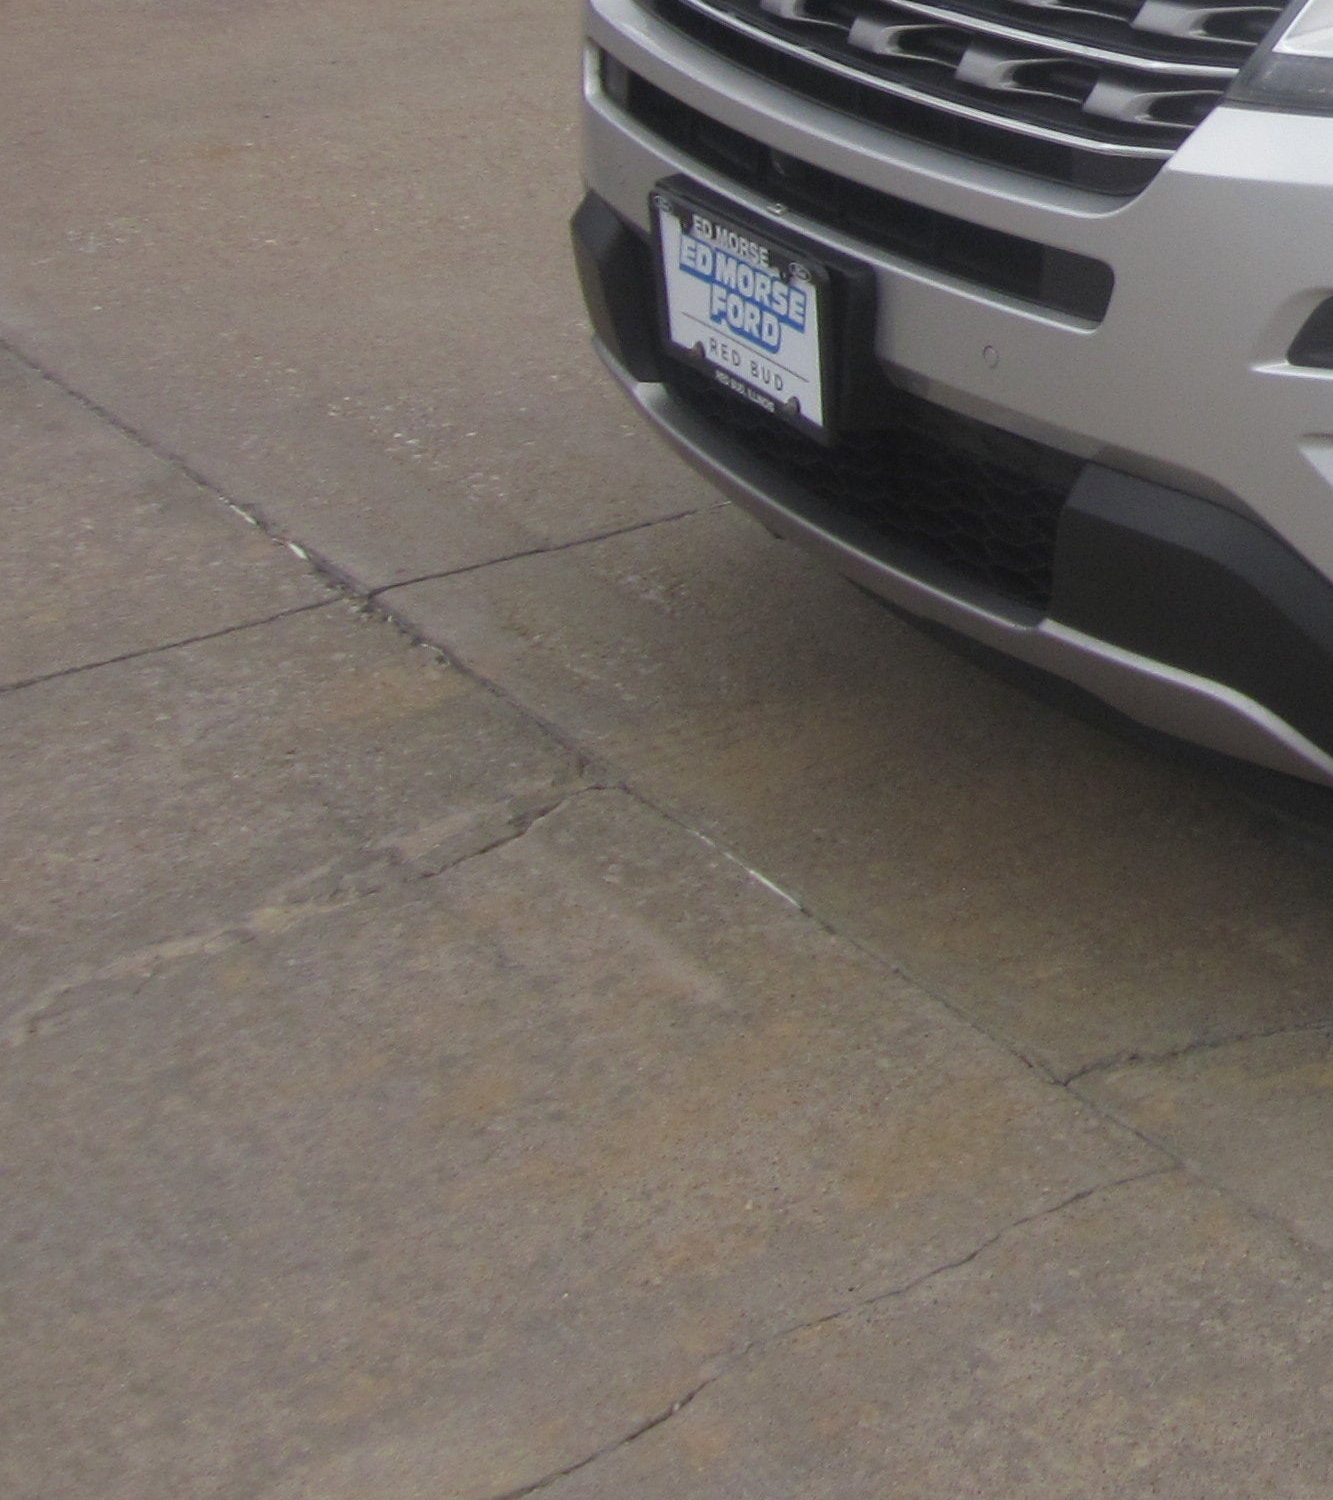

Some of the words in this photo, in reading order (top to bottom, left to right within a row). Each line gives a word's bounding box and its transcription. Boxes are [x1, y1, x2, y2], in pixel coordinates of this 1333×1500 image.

[692, 214, 713, 240] ED
[715, 225, 770, 269] MORSE
[679, 233, 714, 284] ED
[713, 247, 806, 334] MORSE
[709, 283, 782, 354] FORD
[708, 337, 742, 368] RED
[750, 360, 784, 392] BUD
